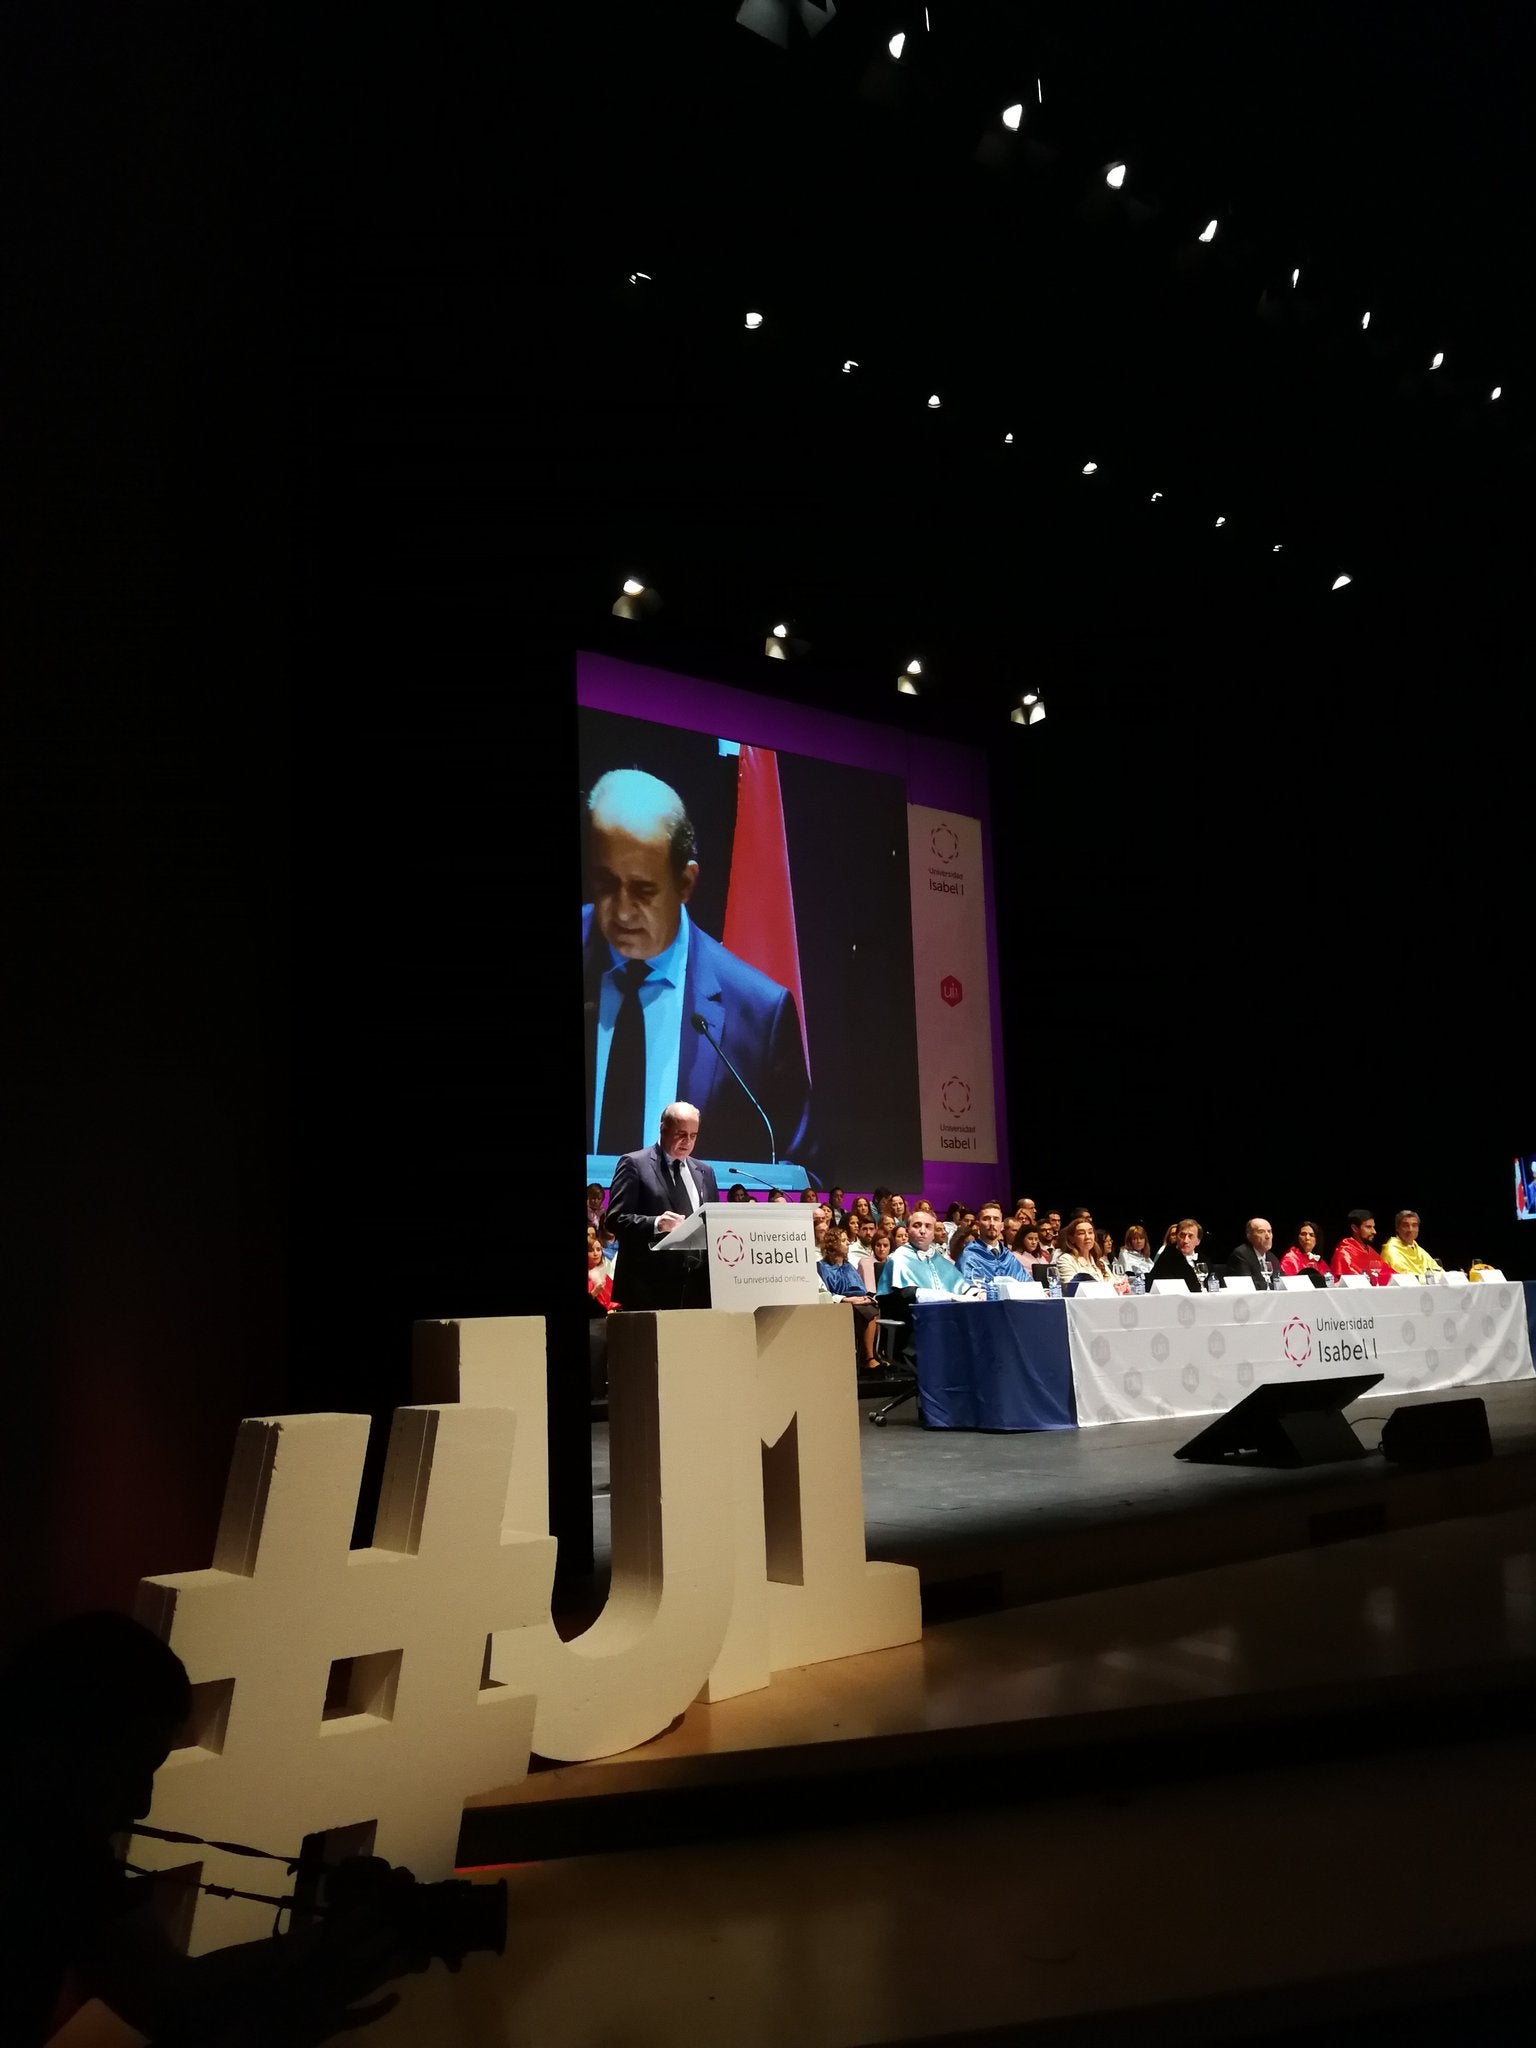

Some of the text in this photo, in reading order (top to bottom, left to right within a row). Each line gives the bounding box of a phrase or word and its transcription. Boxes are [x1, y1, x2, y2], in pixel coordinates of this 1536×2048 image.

[928, 868, 964, 880] Universidad
[929, 879, 959, 895] Isabel
[940, 1123, 976, 1133] Universidad
[940, 1135, 971, 1150] Isabel
[750, 1232, 807, 1242] Universidad
[751, 1247, 809, 1264] Isabel I
[734, 1276, 742, 1285] Tu
[743, 1275, 783, 1284] universidad
[1316, 1316, 1374, 1332] Universidad
[1318, 1337, 1378, 1363] Isabel I
